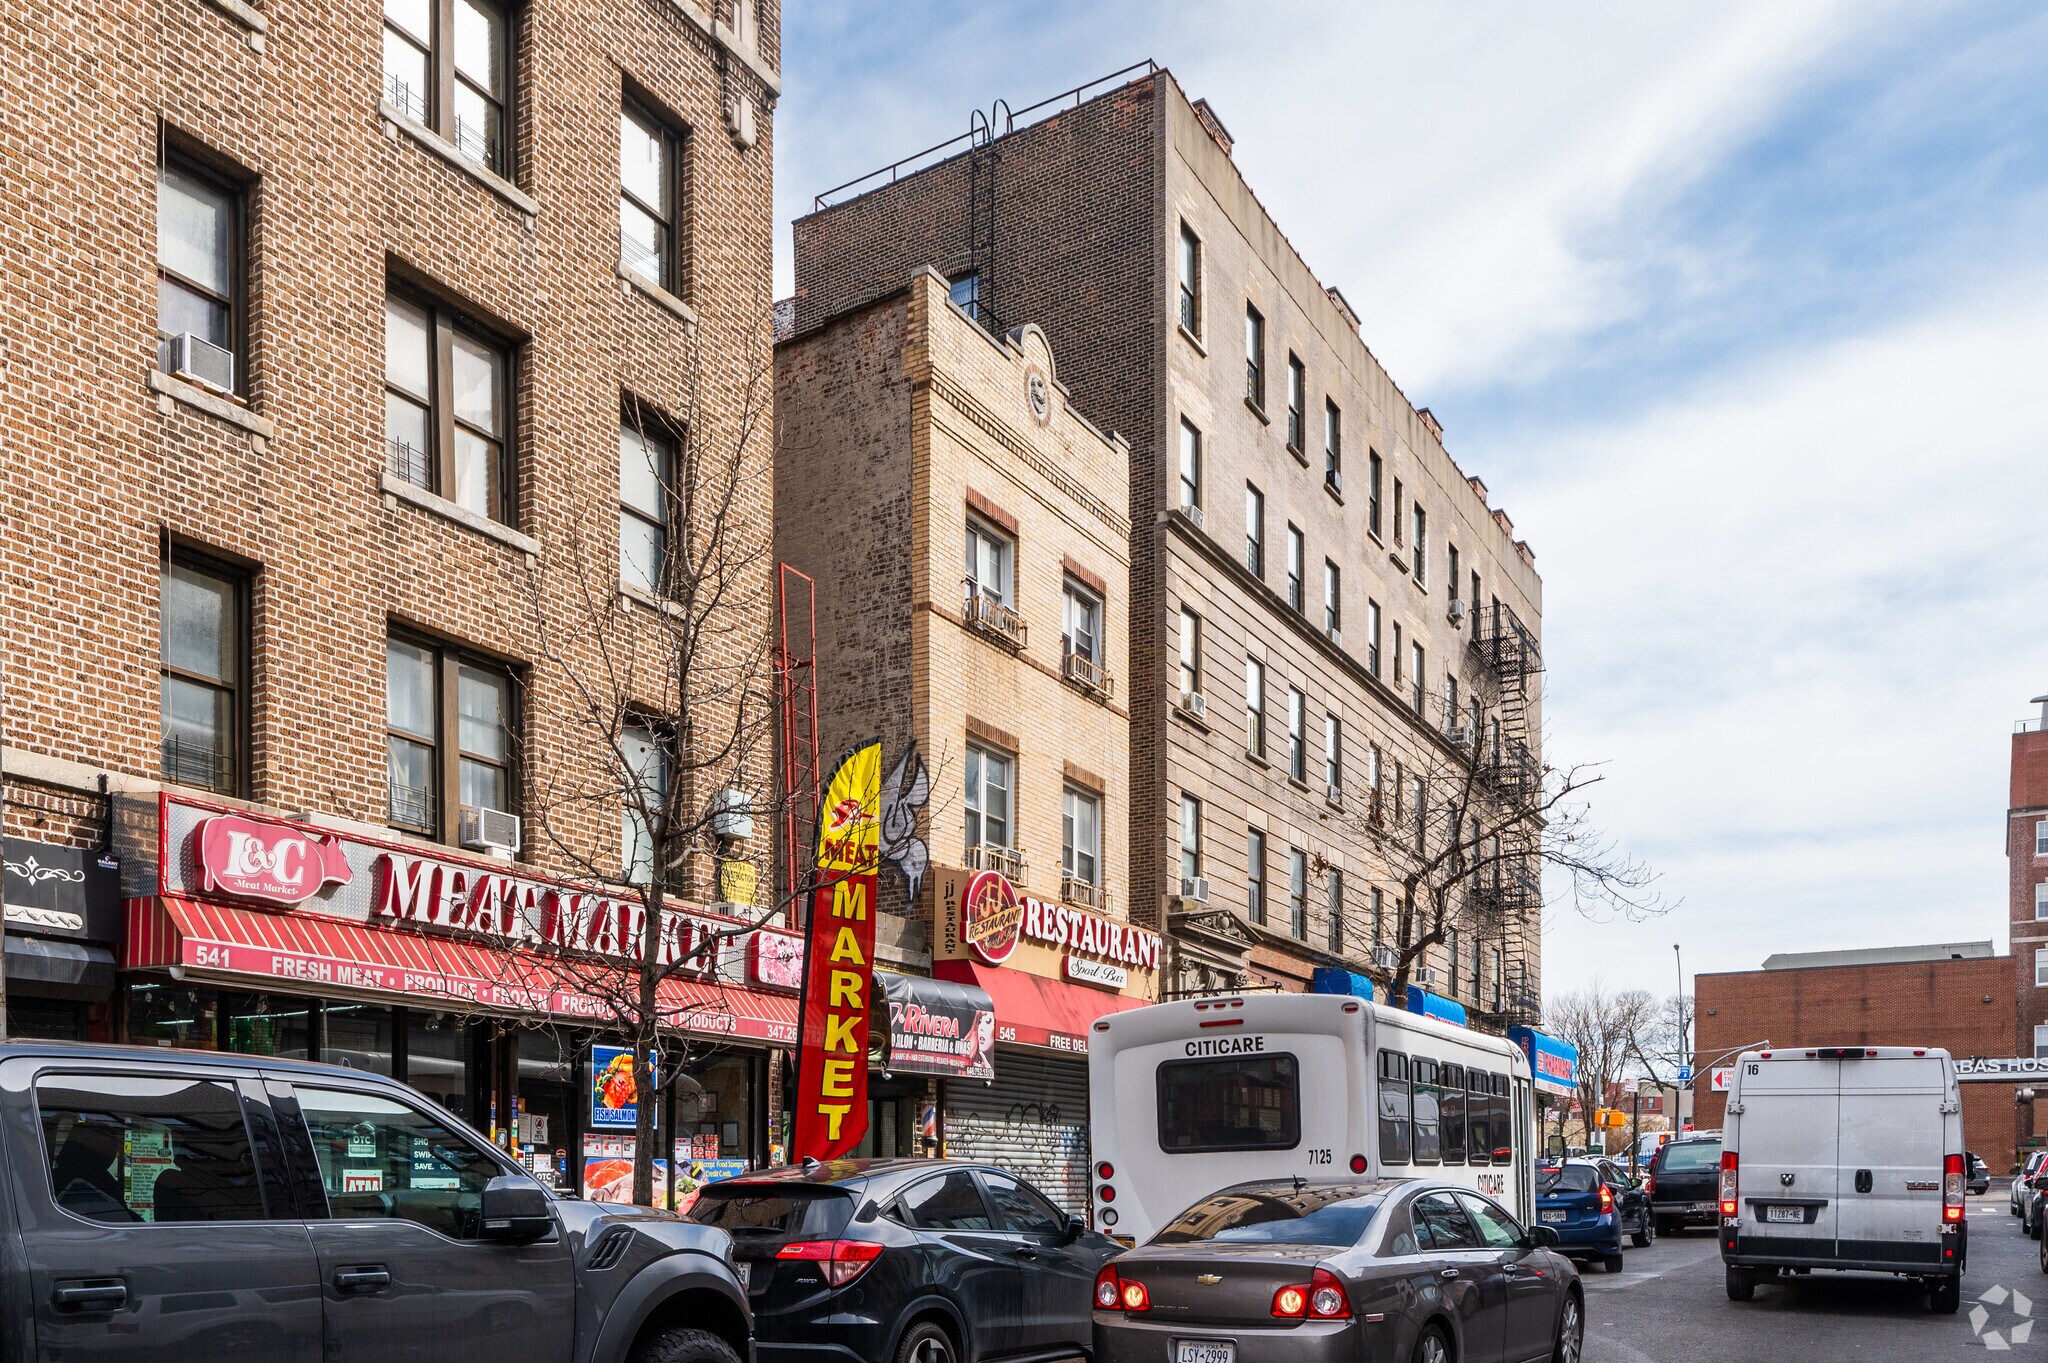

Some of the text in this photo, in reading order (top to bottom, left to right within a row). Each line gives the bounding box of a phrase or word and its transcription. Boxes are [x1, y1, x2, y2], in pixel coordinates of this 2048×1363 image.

[223, 830, 307, 886] I&C
[825, 838, 879, 868] MEAT
[381, 853, 737, 976] MEAT MARKET
[969, 908, 1022, 939] RESTAURANT
[944, 901, 956, 954] RESTAURANT
[1026, 897, 1163, 970] RESTAURANT
[1071, 960, 1124, 983] Sport Bar
[196, 946, 230, 967] 541
[272, 956, 331, 981] FRESH
[337, 966, 383, 987] MEAT
[404, 973, 477, 1000] PRODUCE
[493, 985, 548, 1010] FROZEN
[679, 1012, 737, 1031] PRODUCTS
[818, 880, 866, 1140] MARKET
[918, 1036, 948, 1053] BARBERIA
[1000, 1027, 1015, 1040] 545
[1050, 1035, 1070, 1050] FREE
[1185, 1036, 1264, 1056] CITICARE
[1747, 1064, 1759, 1075] 16
[594, 1107, 637, 1122] FISH SALMON
[353, 1136, 371, 1144] OTC
[1308, 1149, 1332, 1165] 7125
[348, 1180, 379, 1192] ATM
[1477, 1174, 1504, 1195] CITICARE
